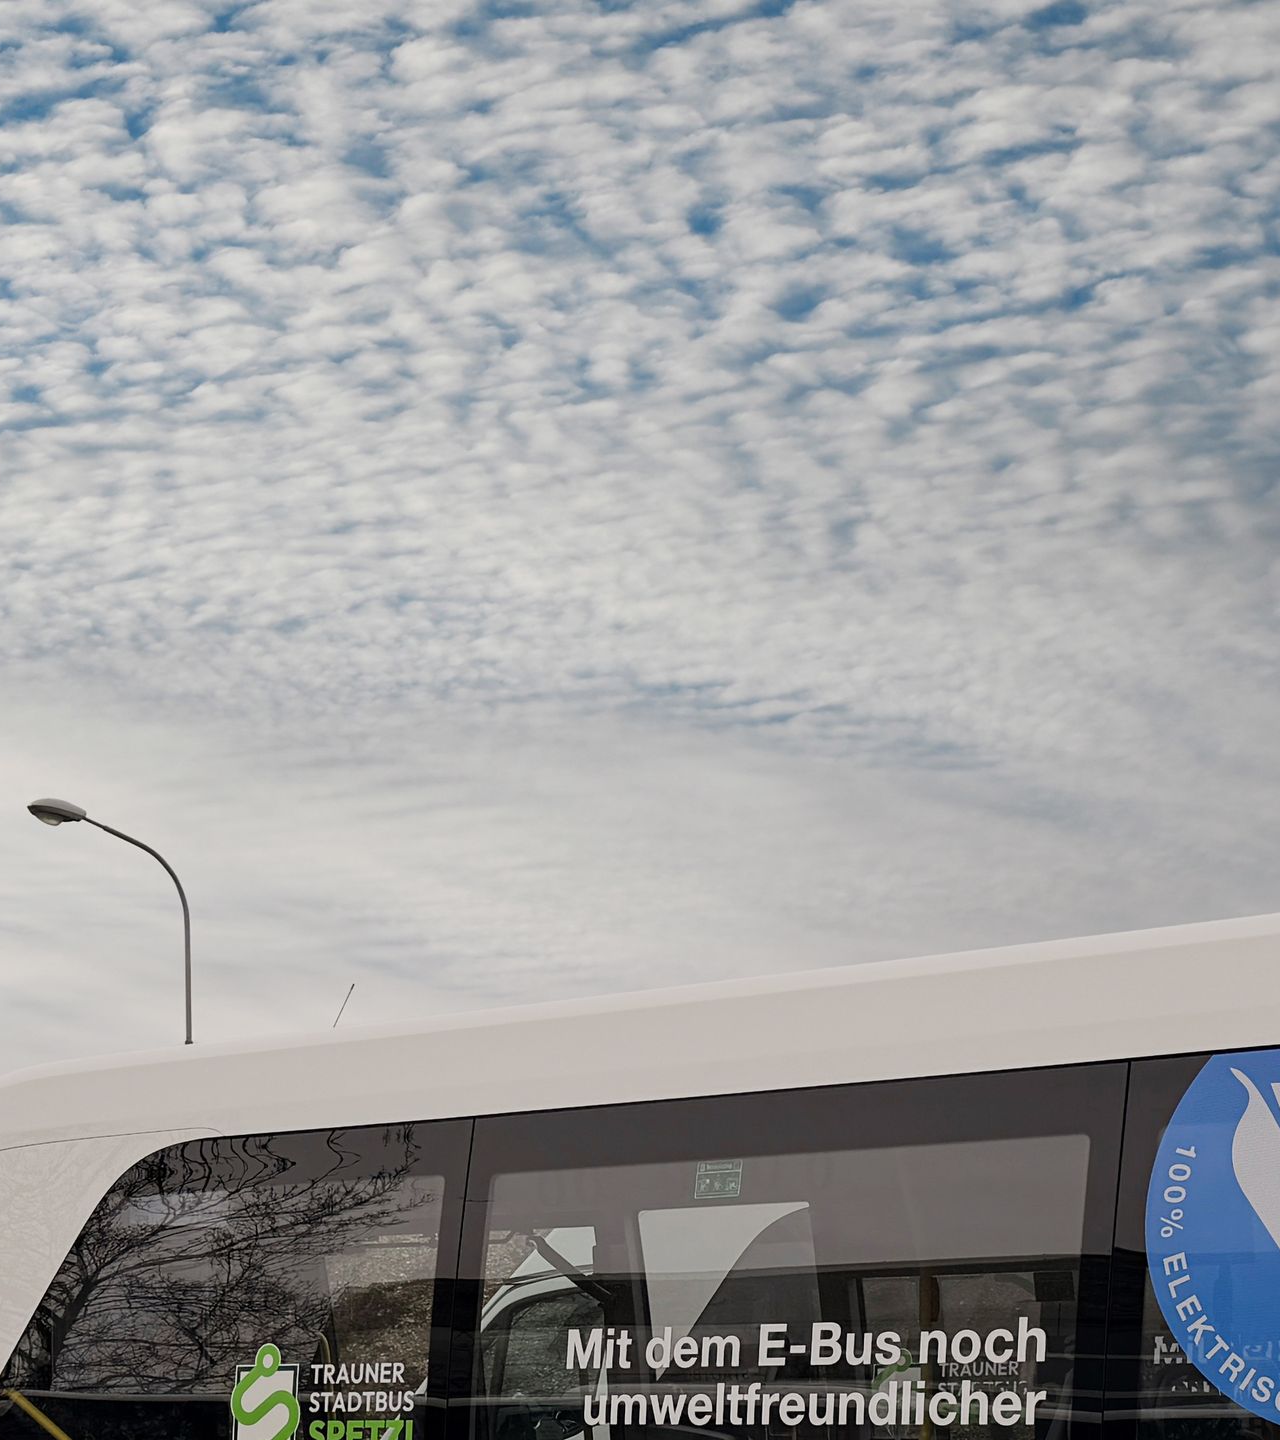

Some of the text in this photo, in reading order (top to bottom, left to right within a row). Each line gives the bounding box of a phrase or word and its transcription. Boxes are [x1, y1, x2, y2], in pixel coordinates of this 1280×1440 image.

[1159, 1145, 1197, 1239] 100%
[566, 1317, 1047, 1370] Mit dem E-Bus noch
[311, 1362, 405, 1384] TRAUNER
[939, 1361, 1020, 1378] TRAUNER
[308, 1390, 415, 1413] STADTBUS
[583, 1381, 1047, 1427] umweltfreundlicher
